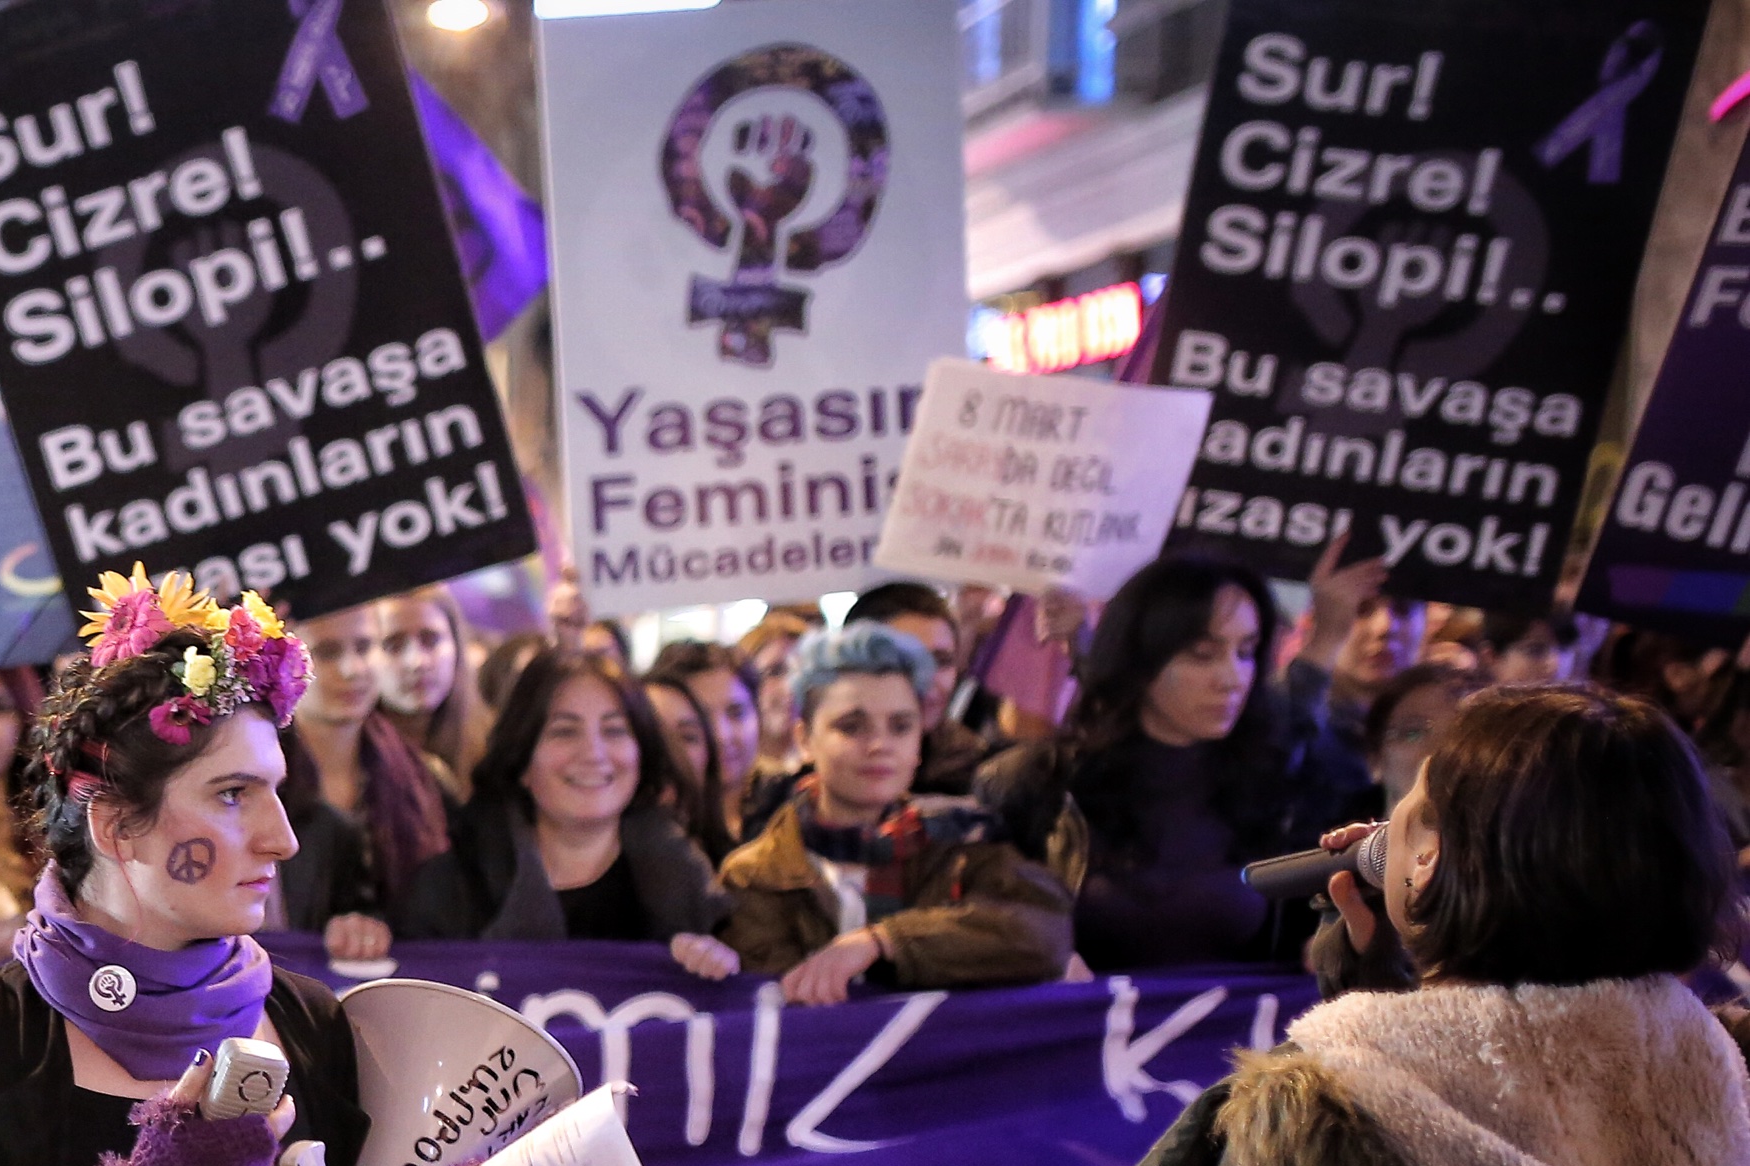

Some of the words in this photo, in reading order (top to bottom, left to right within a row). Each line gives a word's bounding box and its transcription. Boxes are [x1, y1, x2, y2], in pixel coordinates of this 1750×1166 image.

[1236, 32, 1443, 121] Sur!
[1220, 120, 1504, 216] Cizre!
[40, 420, 157, 491] Bu
[177, 326, 467, 450] savaşa
[958, 388, 984, 429] 8
[1171, 328, 1278, 398] Bu
[1301, 361, 1583, 444] savaşa
[64, 403, 483, 563] kadınların
[590, 453, 900, 535] Femini
[1204, 415, 1560, 505] adınların
[327, 460, 509, 577] yok!
[1177, 486, 1353, 547] ızası
[1380, 516, 1551, 578] yok!
